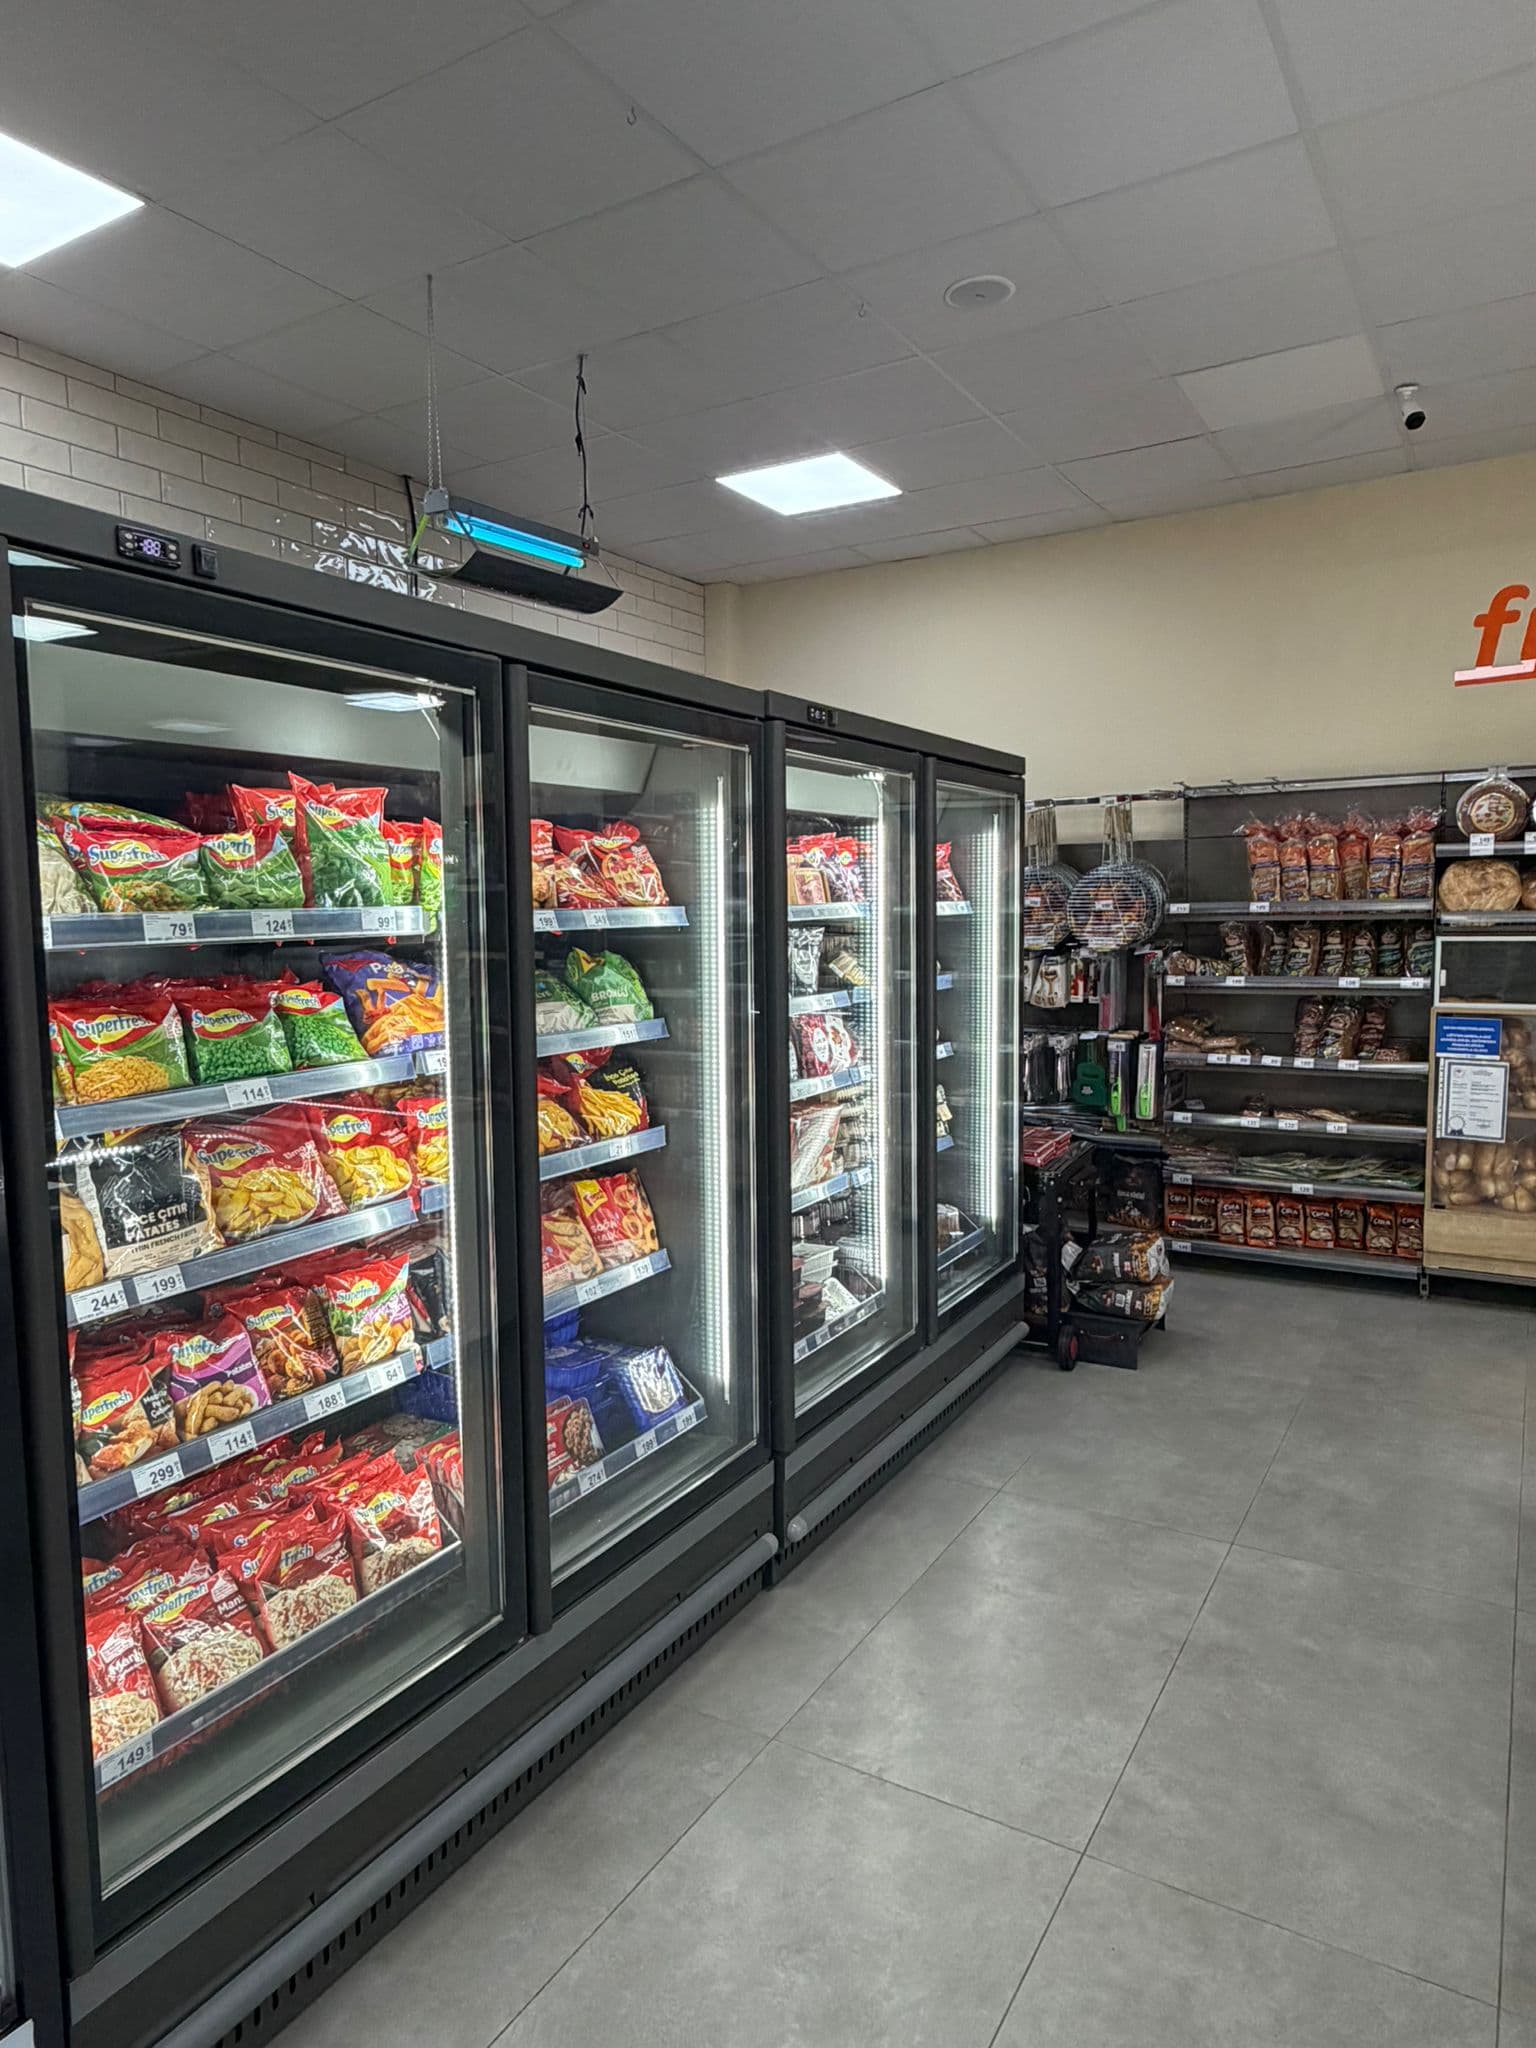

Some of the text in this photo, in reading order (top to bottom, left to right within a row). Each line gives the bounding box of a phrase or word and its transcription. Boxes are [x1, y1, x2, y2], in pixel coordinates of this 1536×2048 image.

[88, 845, 168, 865] SupFresh
[170, 923, 187, 937] 79
[266, 919, 287, 932] 124
[378, 916, 391, 928] 99
[242, 1086, 264, 1100] 114
[126, 1220, 180, 1242] PATATES
[152, 1276, 177, 1294] 199
[91, 1292, 118, 1312] 244
[319, 1394, 338, 1410] 188
[225, 1436, 247, 1451] 114
[150, 1465, 174, 1486] 299
[117, 1745, 145, 1770] 149
